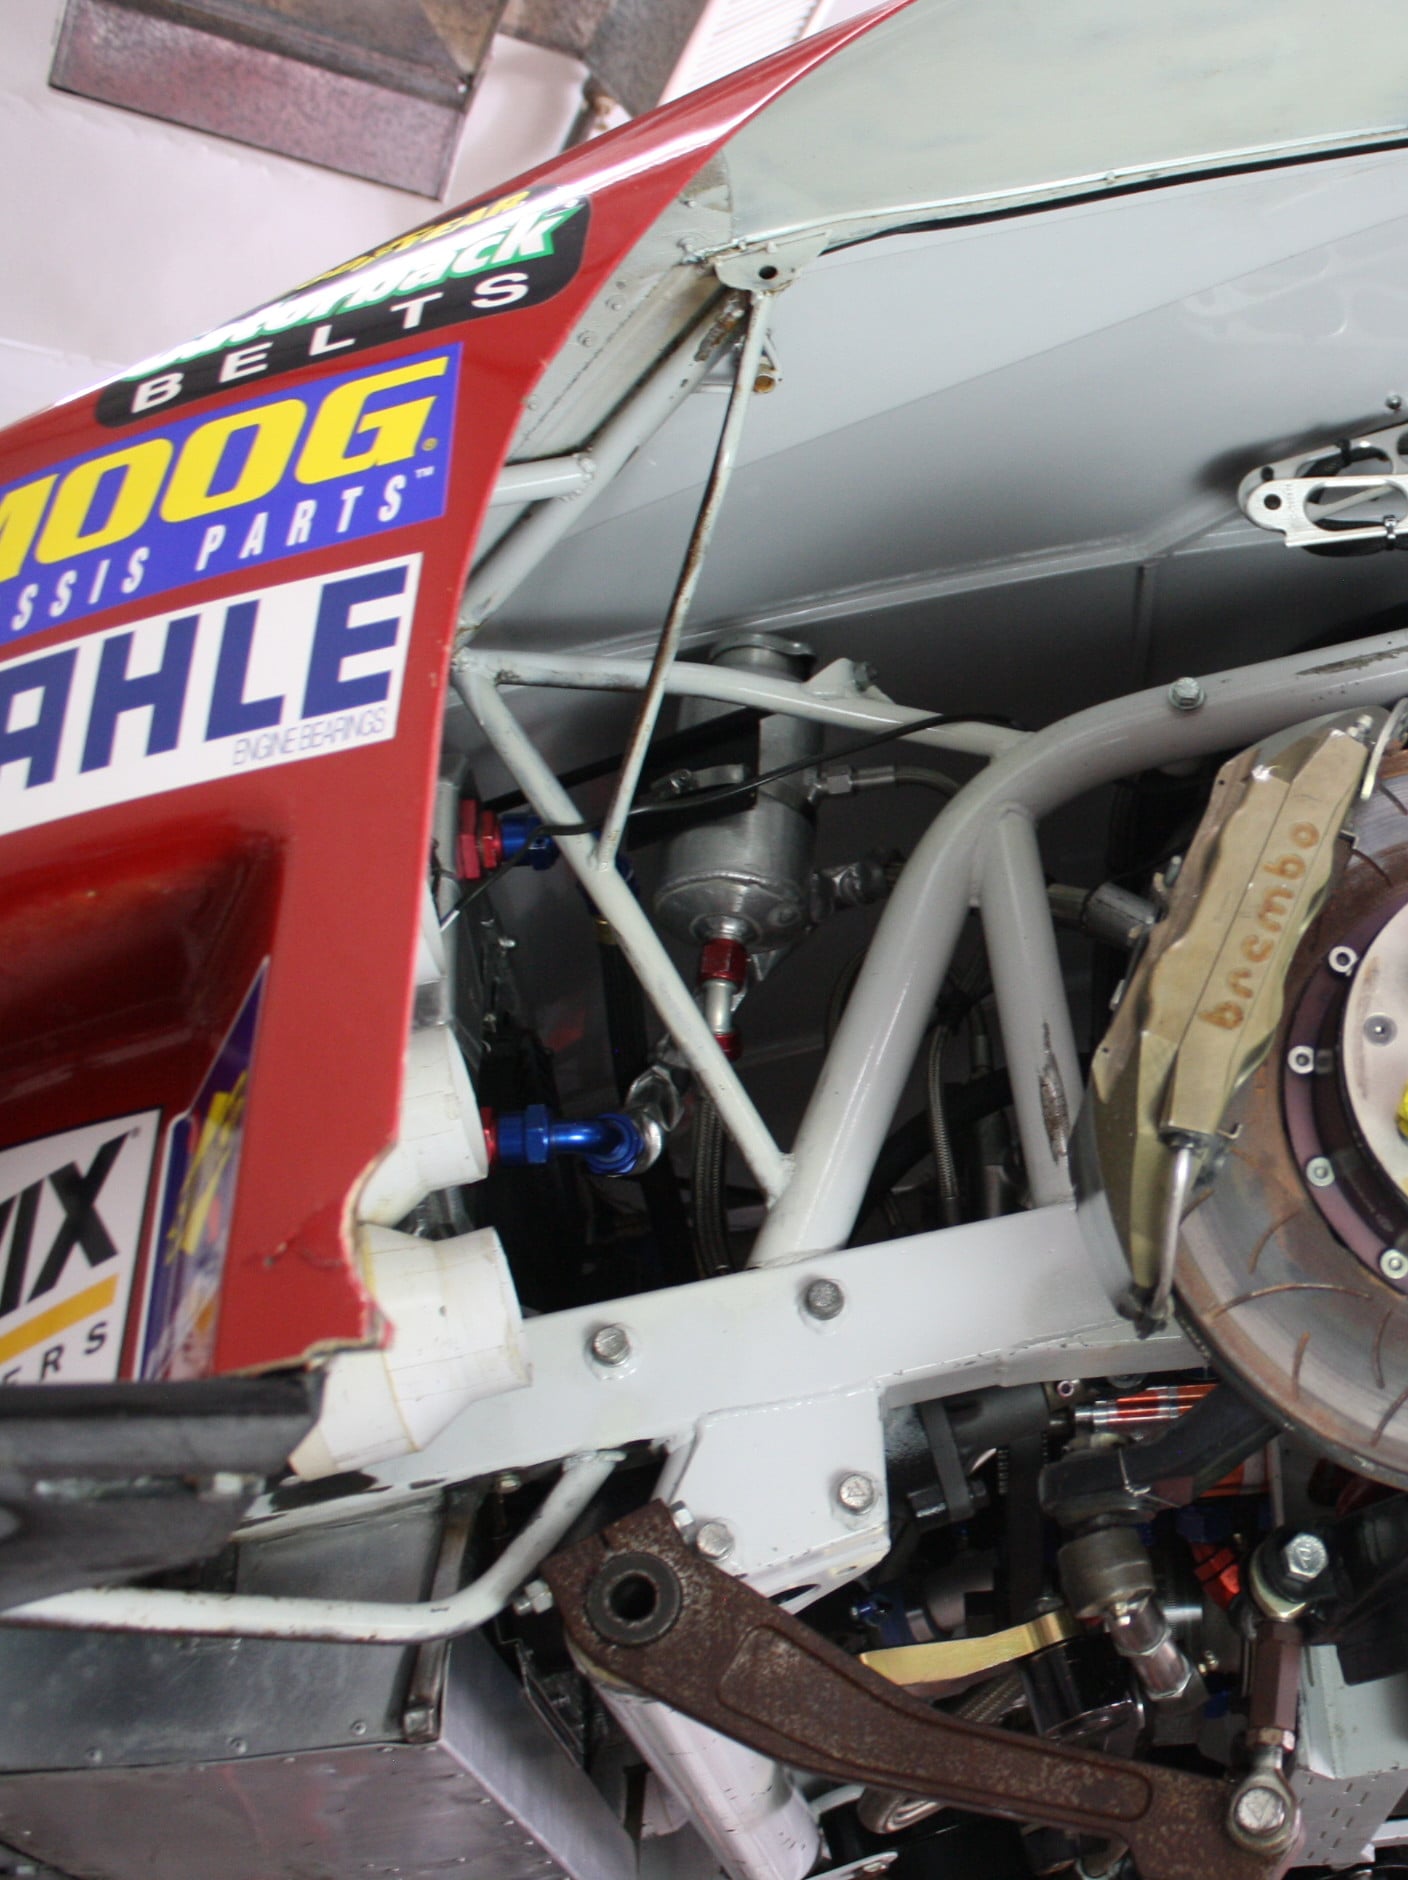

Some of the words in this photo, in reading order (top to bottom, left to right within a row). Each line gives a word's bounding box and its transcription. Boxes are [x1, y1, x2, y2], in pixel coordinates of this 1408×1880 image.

[131, 272, 530, 414] BELTS
[12, 547, 150, 631] SSIS
[195, 475, 406, 571] PARTS
[232, 726, 299, 766] ENGINE
[298, 706, 387, 751] BEARINGS
[1198, 821, 1321, 1031] brembo
